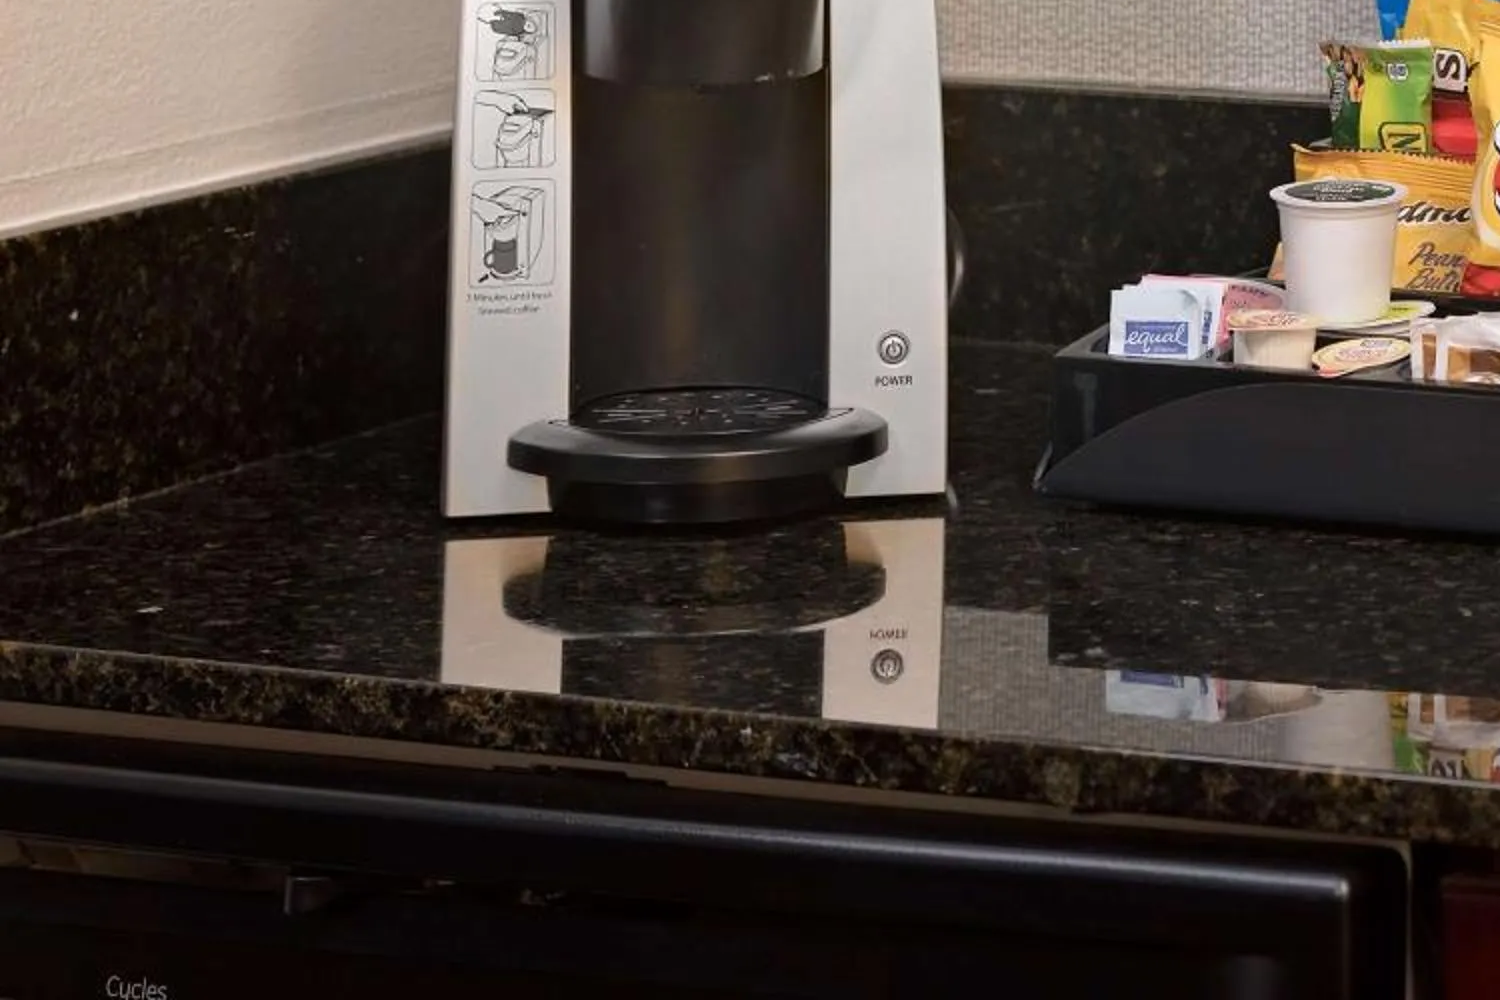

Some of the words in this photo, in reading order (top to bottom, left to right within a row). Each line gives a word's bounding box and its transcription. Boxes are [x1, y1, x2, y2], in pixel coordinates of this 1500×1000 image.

[1408, 241, 1466, 268] Pean
[1408, 267, 1460, 293] Butt
[1126, 322, 1189, 353] equal
[874, 375, 913, 387] POWER
[105, 974, 168, 1000] Cycles
